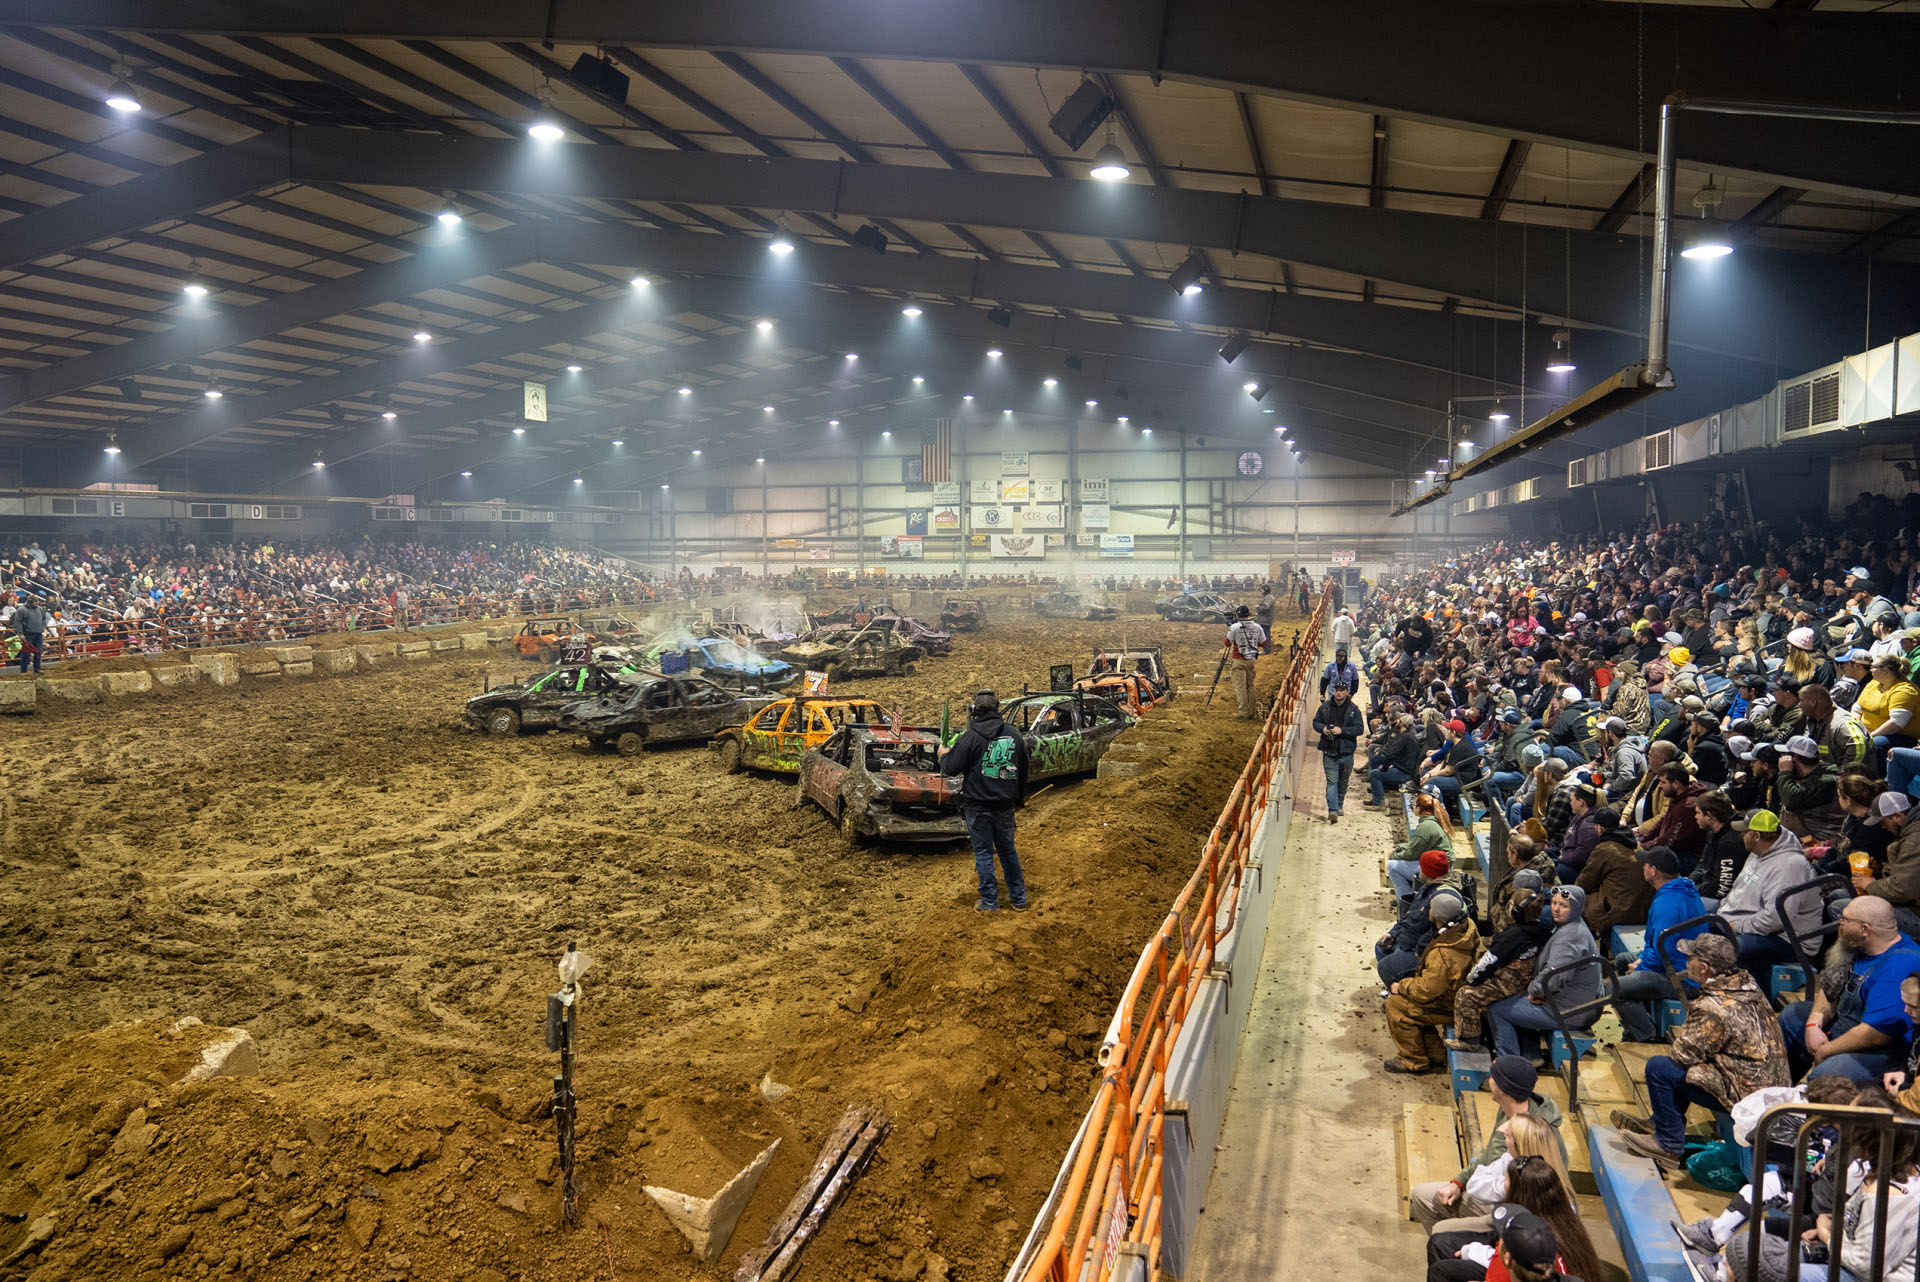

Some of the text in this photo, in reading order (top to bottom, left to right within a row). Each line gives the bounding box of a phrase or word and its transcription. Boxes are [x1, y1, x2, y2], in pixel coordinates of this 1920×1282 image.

[1083, 480, 1105, 489] imi
[113, 502, 123, 516] E
[253, 505, 261, 518] D
[407, 509, 414, 520] C
[491, 510, 497, 520] B
[564, 649, 586, 663] 42
[809, 676, 823, 692] 7
